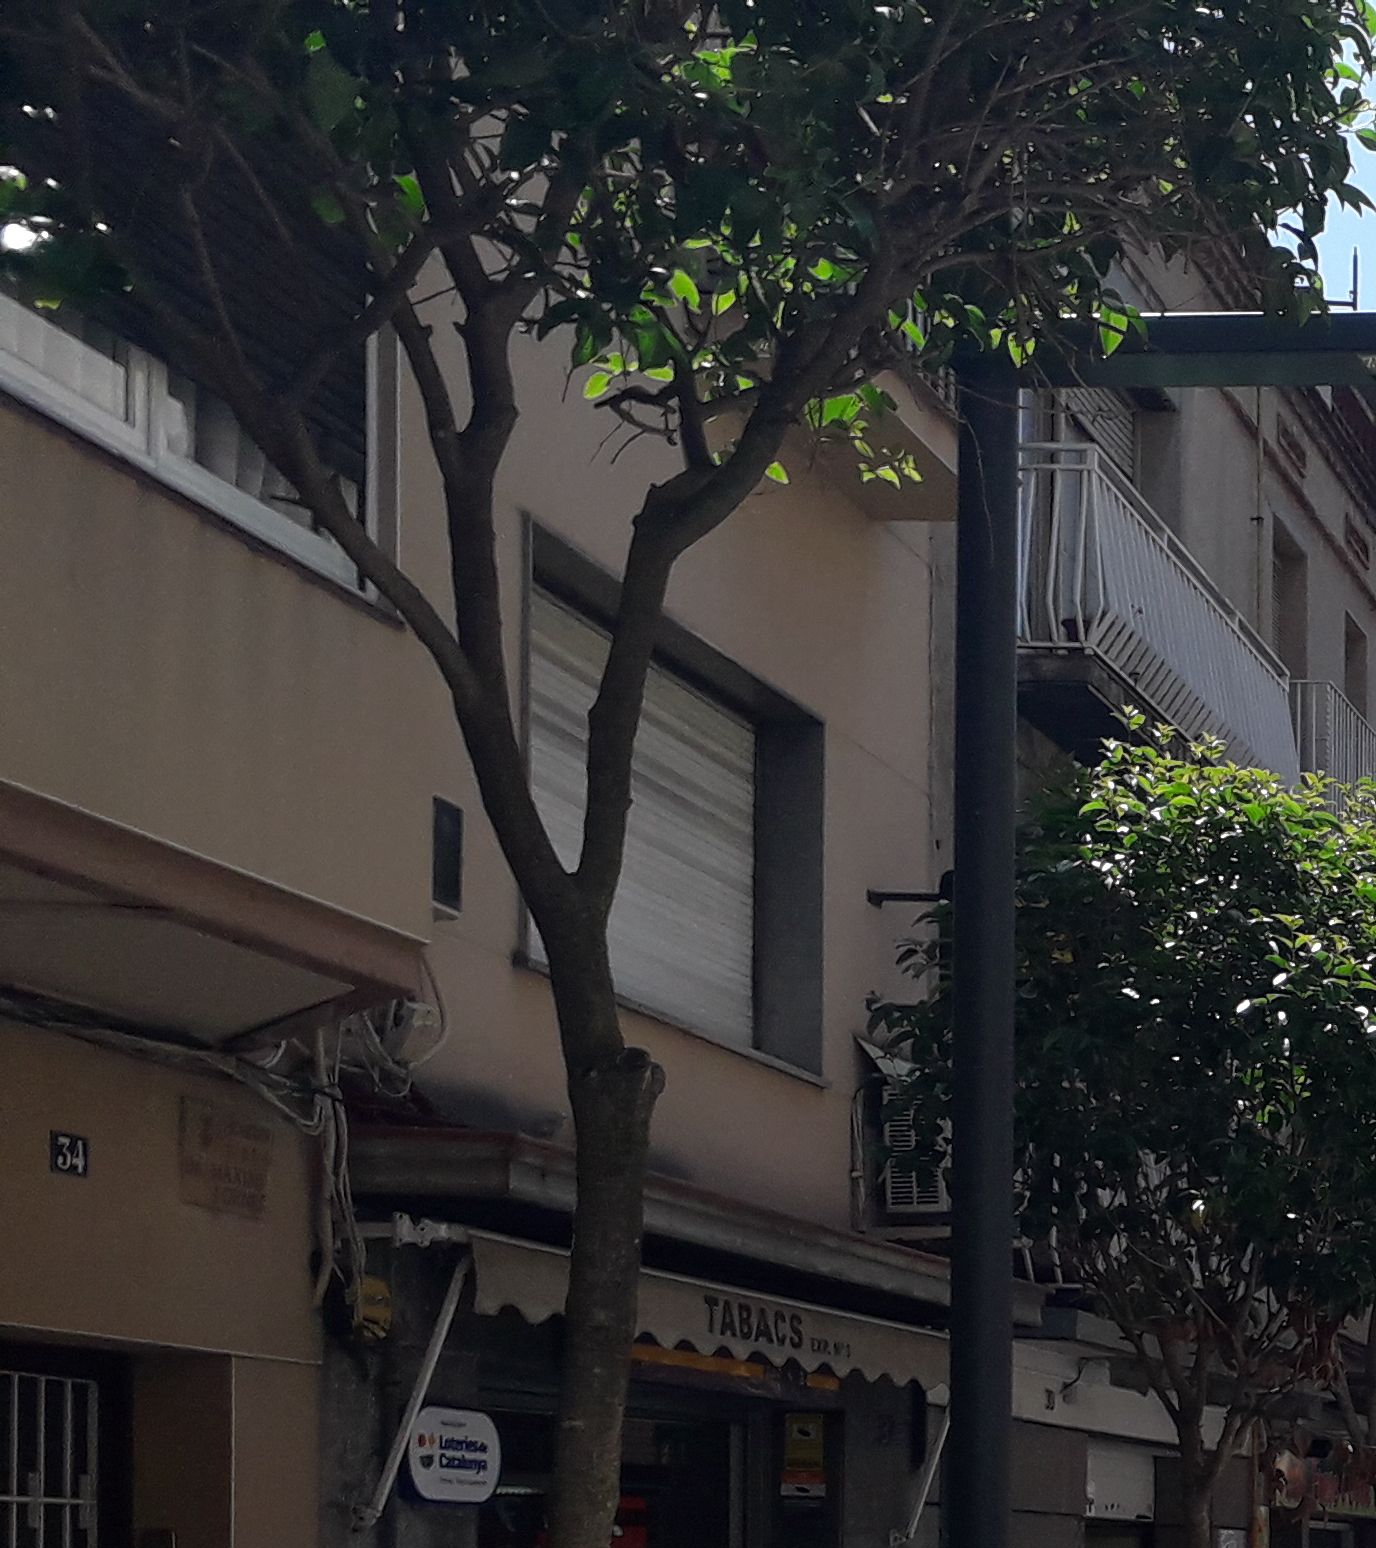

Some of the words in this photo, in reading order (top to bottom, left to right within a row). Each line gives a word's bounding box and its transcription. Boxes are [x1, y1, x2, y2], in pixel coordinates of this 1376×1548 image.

[57, 1135, 86, 1174] 34
[703, 1294, 804, 1349] TABACS
[440, 1453, 487, 1474] Catalunya
